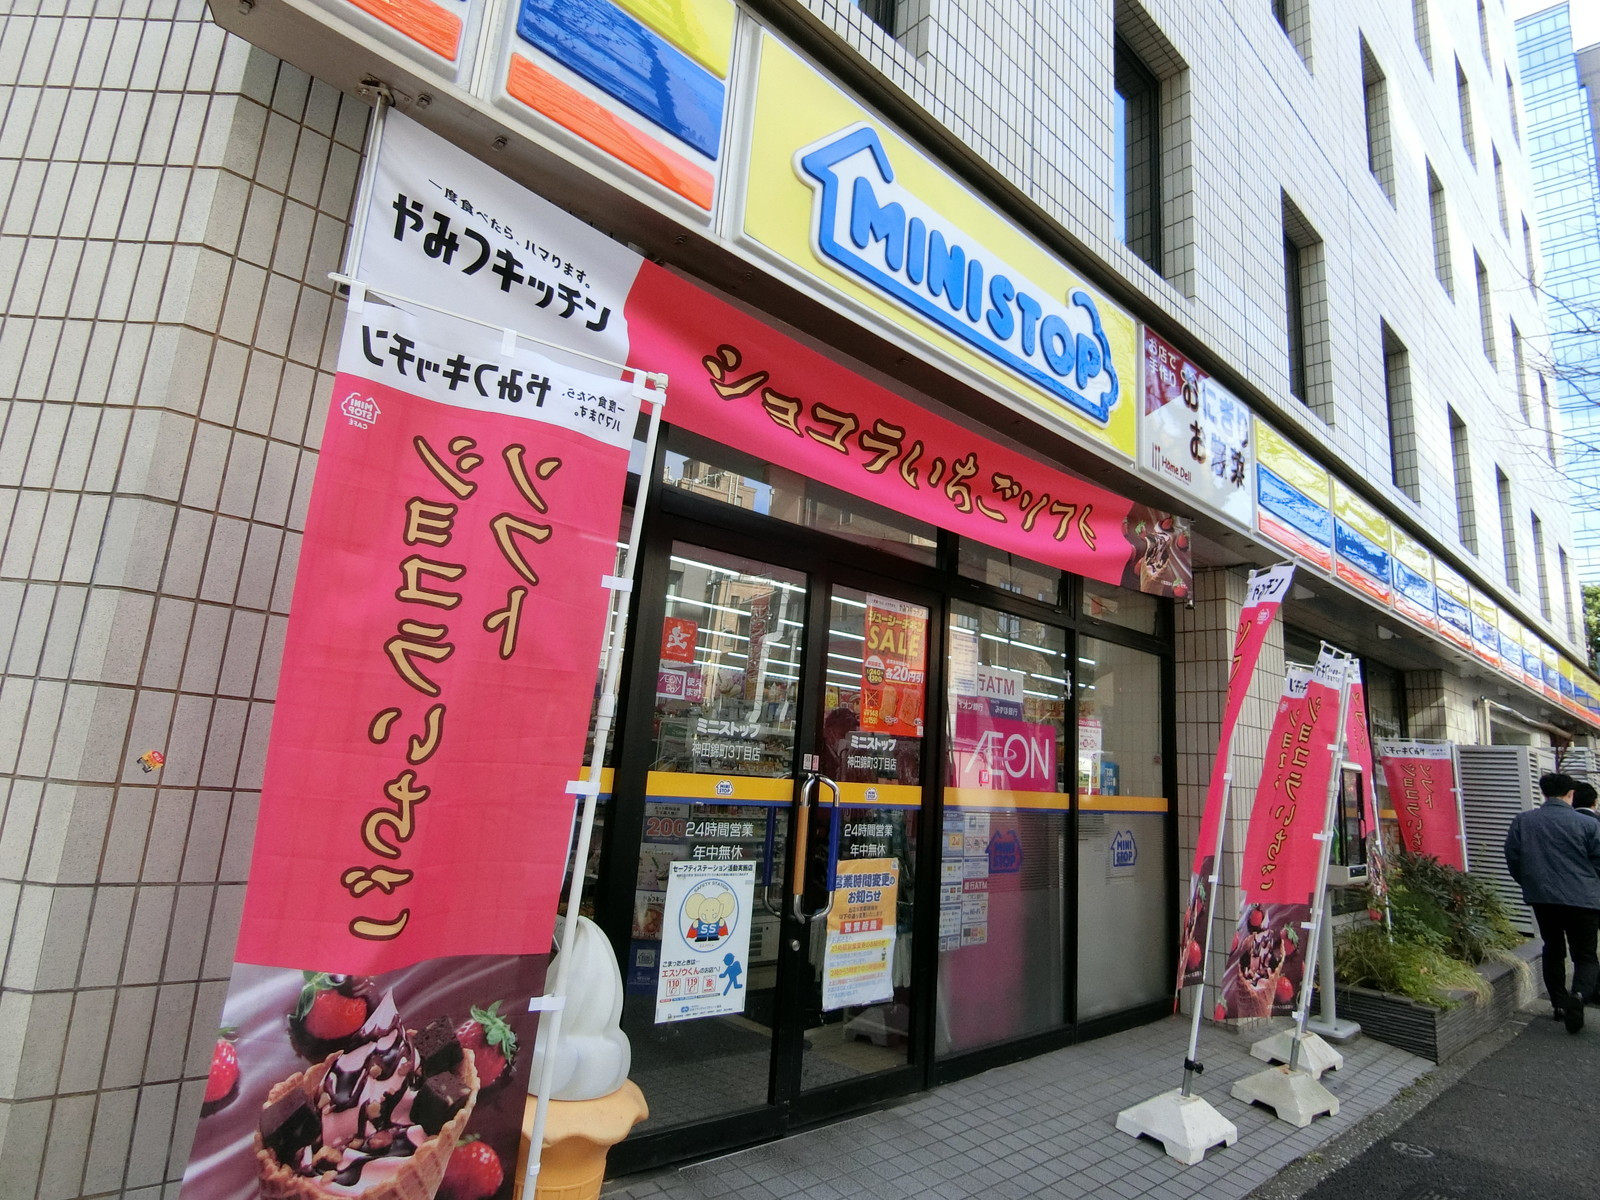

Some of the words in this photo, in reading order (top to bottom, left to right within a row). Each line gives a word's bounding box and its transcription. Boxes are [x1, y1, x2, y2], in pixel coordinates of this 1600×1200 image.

[393, 193, 612, 332] やみつキッチン
[850, 175, 1103, 390] MINISTOP
[1148, 338, 1177, 370] お店で
[1148, 357, 1177, 388] 手作り
[702, 345, 1097, 550] ショコラいちごソフト
[1161, 455, 1180, 477] Home
[1179, 466, 1192, 483] Deli
[867, 625, 921, 657] SALE
[697, 717, 761, 738] ミニストップ
[850, 735, 896, 751] ミニストップ
[691, 742, 761, 761] 神田錦町3丁目店
[847, 754, 897, 771] 神田錦町3丁目店
[685, 822, 754, 838] 24時間営業
[844, 824, 893, 837] 24時間営業
[693, 845, 743, 860] 年中無休
[850, 843, 886, 857] 年中無休
[1116, 840, 1132, 850] MINI
[1116, 851, 1132, 862] STOP
[847, 890, 882, 905] お知らせ
[700, 924, 717, 934] SS
[687, 978, 697, 986] 119
